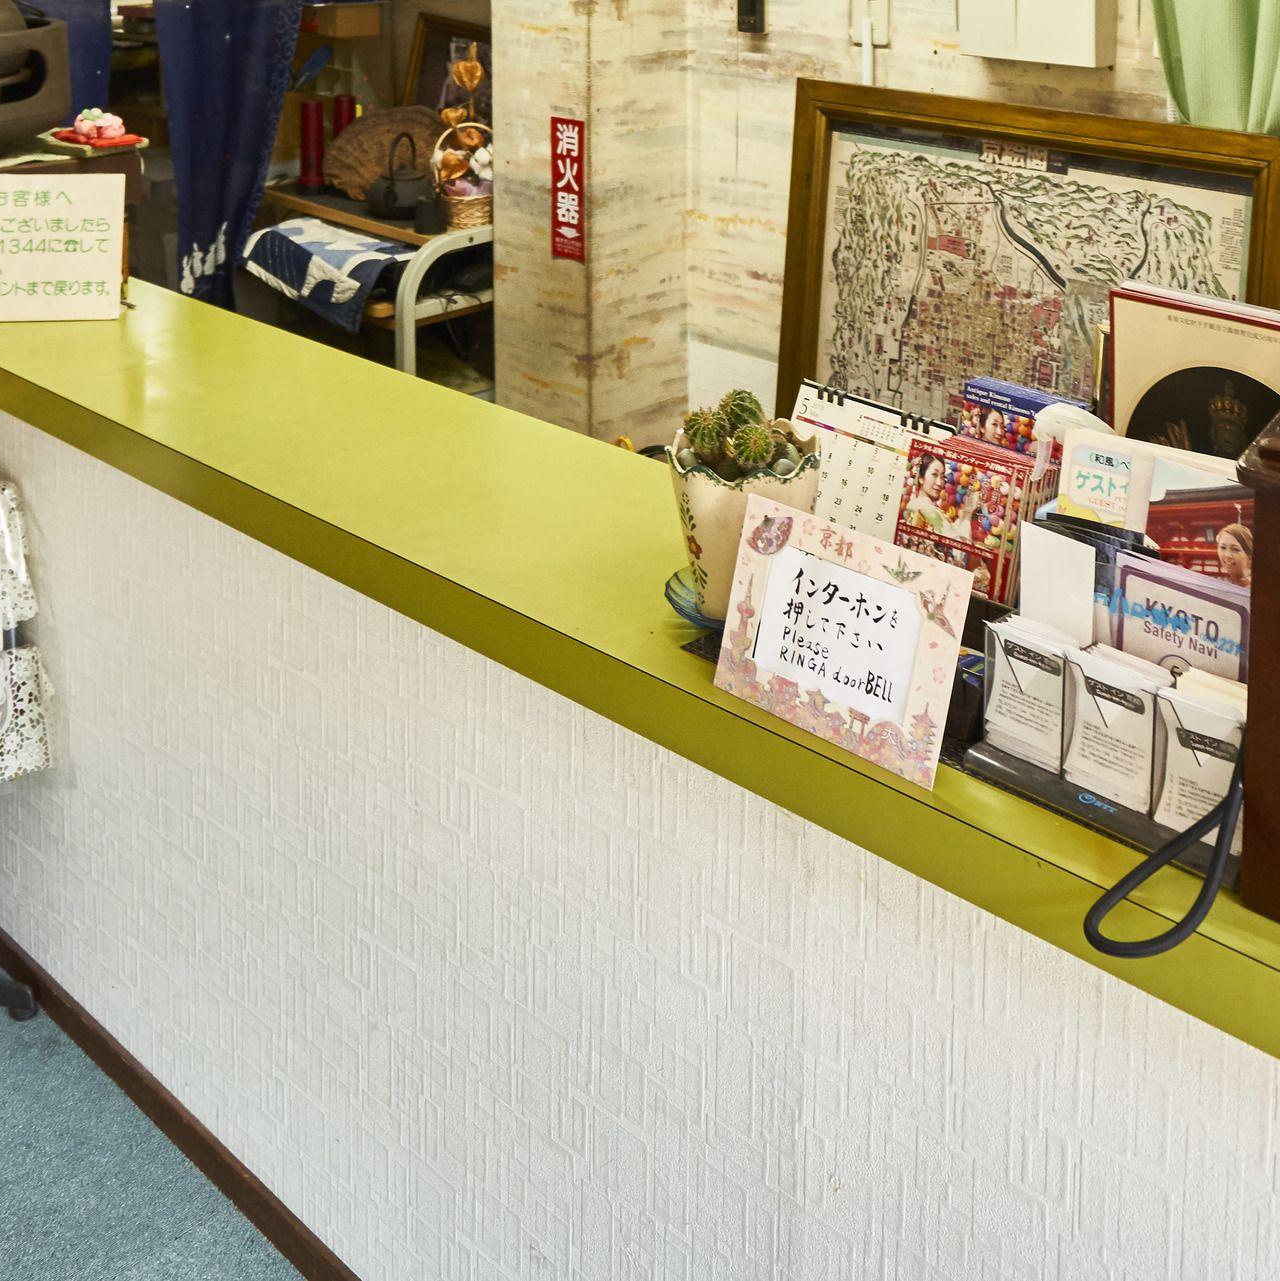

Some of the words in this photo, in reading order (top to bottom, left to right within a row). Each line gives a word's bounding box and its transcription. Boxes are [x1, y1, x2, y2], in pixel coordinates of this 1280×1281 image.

[556, 122, 579, 225] 消火器
[798, 397, 810, 415] 5
[821, 471, 829, 479] 15
[841, 478, 848, 487] 16
[862, 486, 869, 494] 17
[882, 493, 890, 502] 18
[888, 474, 895, 482] 11
[834, 497, 843, 506] 23
[854, 505, 863, 514] 24
[875, 512, 884, 522] 25
[819, 526, 854, 562] 京都
[792, 567, 900, 629] インターホンを
[782, 597, 884, 652] 押して下さい
[1144, 596, 1220, 643] KYOTO
[782, 626, 830, 660] Please
[1143, 619, 1184, 649] Safety
[1189, 636, 1218, 660] Navi
[832, 667, 894, 704] doorBELL
